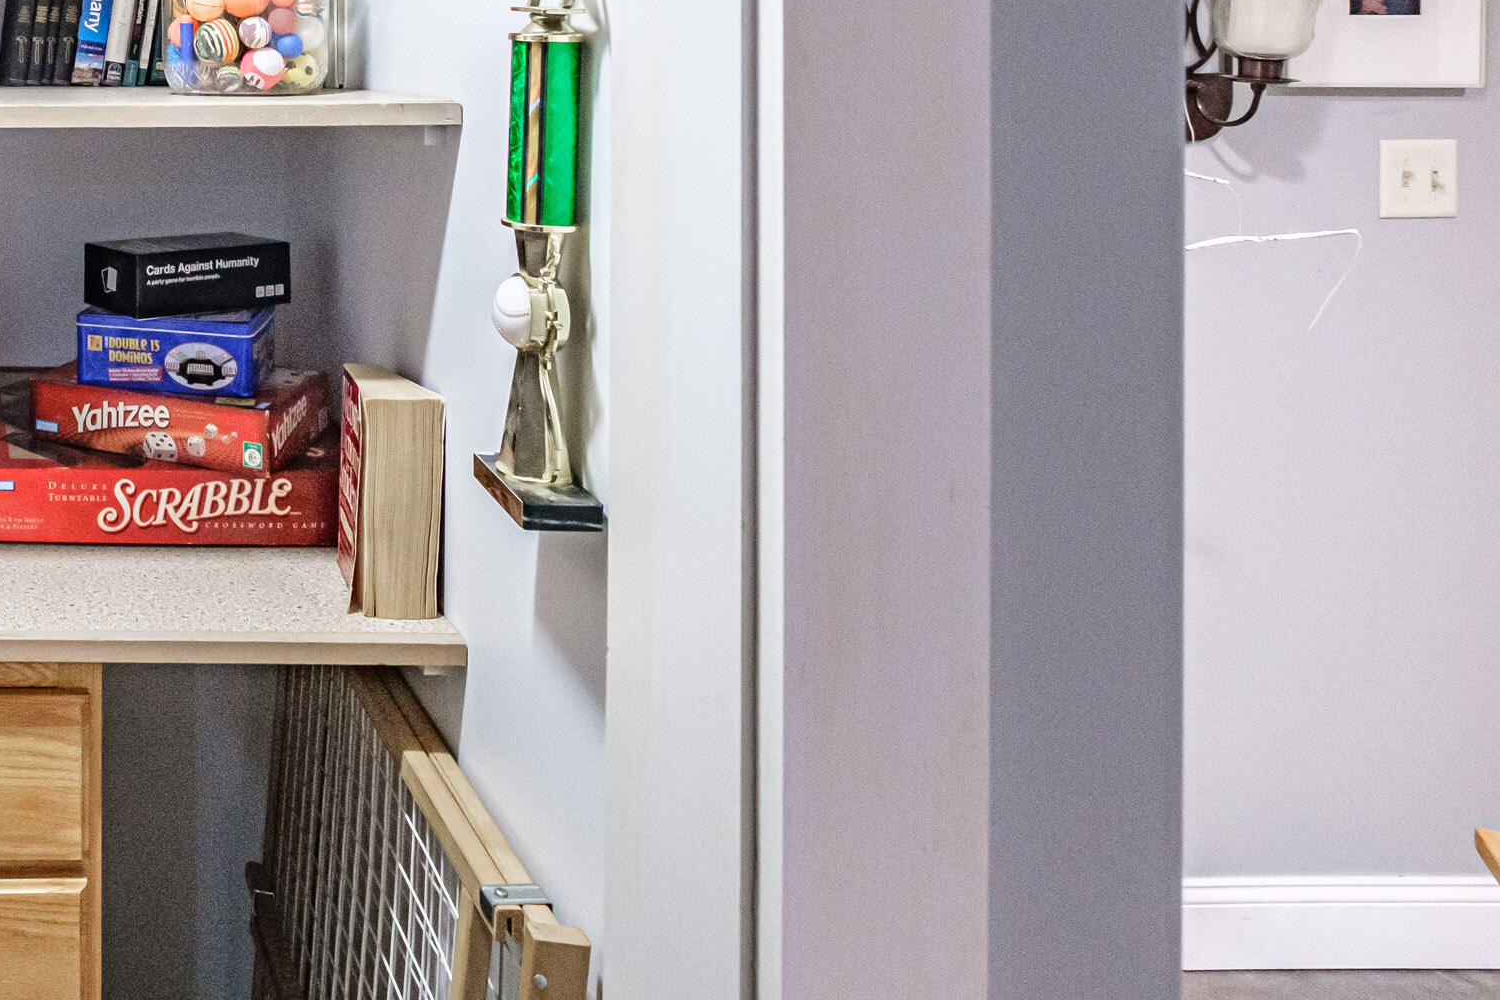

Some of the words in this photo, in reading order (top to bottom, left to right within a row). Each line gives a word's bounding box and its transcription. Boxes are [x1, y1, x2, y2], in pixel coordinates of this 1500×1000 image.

[146, 262, 175, 276] Cards
[177, 259, 213, 274] Against
[215, 256, 260, 270] Humanity
[150, 339, 160, 352] 15
[71, 400, 171, 433] Yahtzee
[271, 395, 308, 457] Yahtzee
[48, 481, 107, 490] DELUXE
[49, 493, 107, 502] TURNTABLE
[97, 478, 293, 533] SCRABBLE
